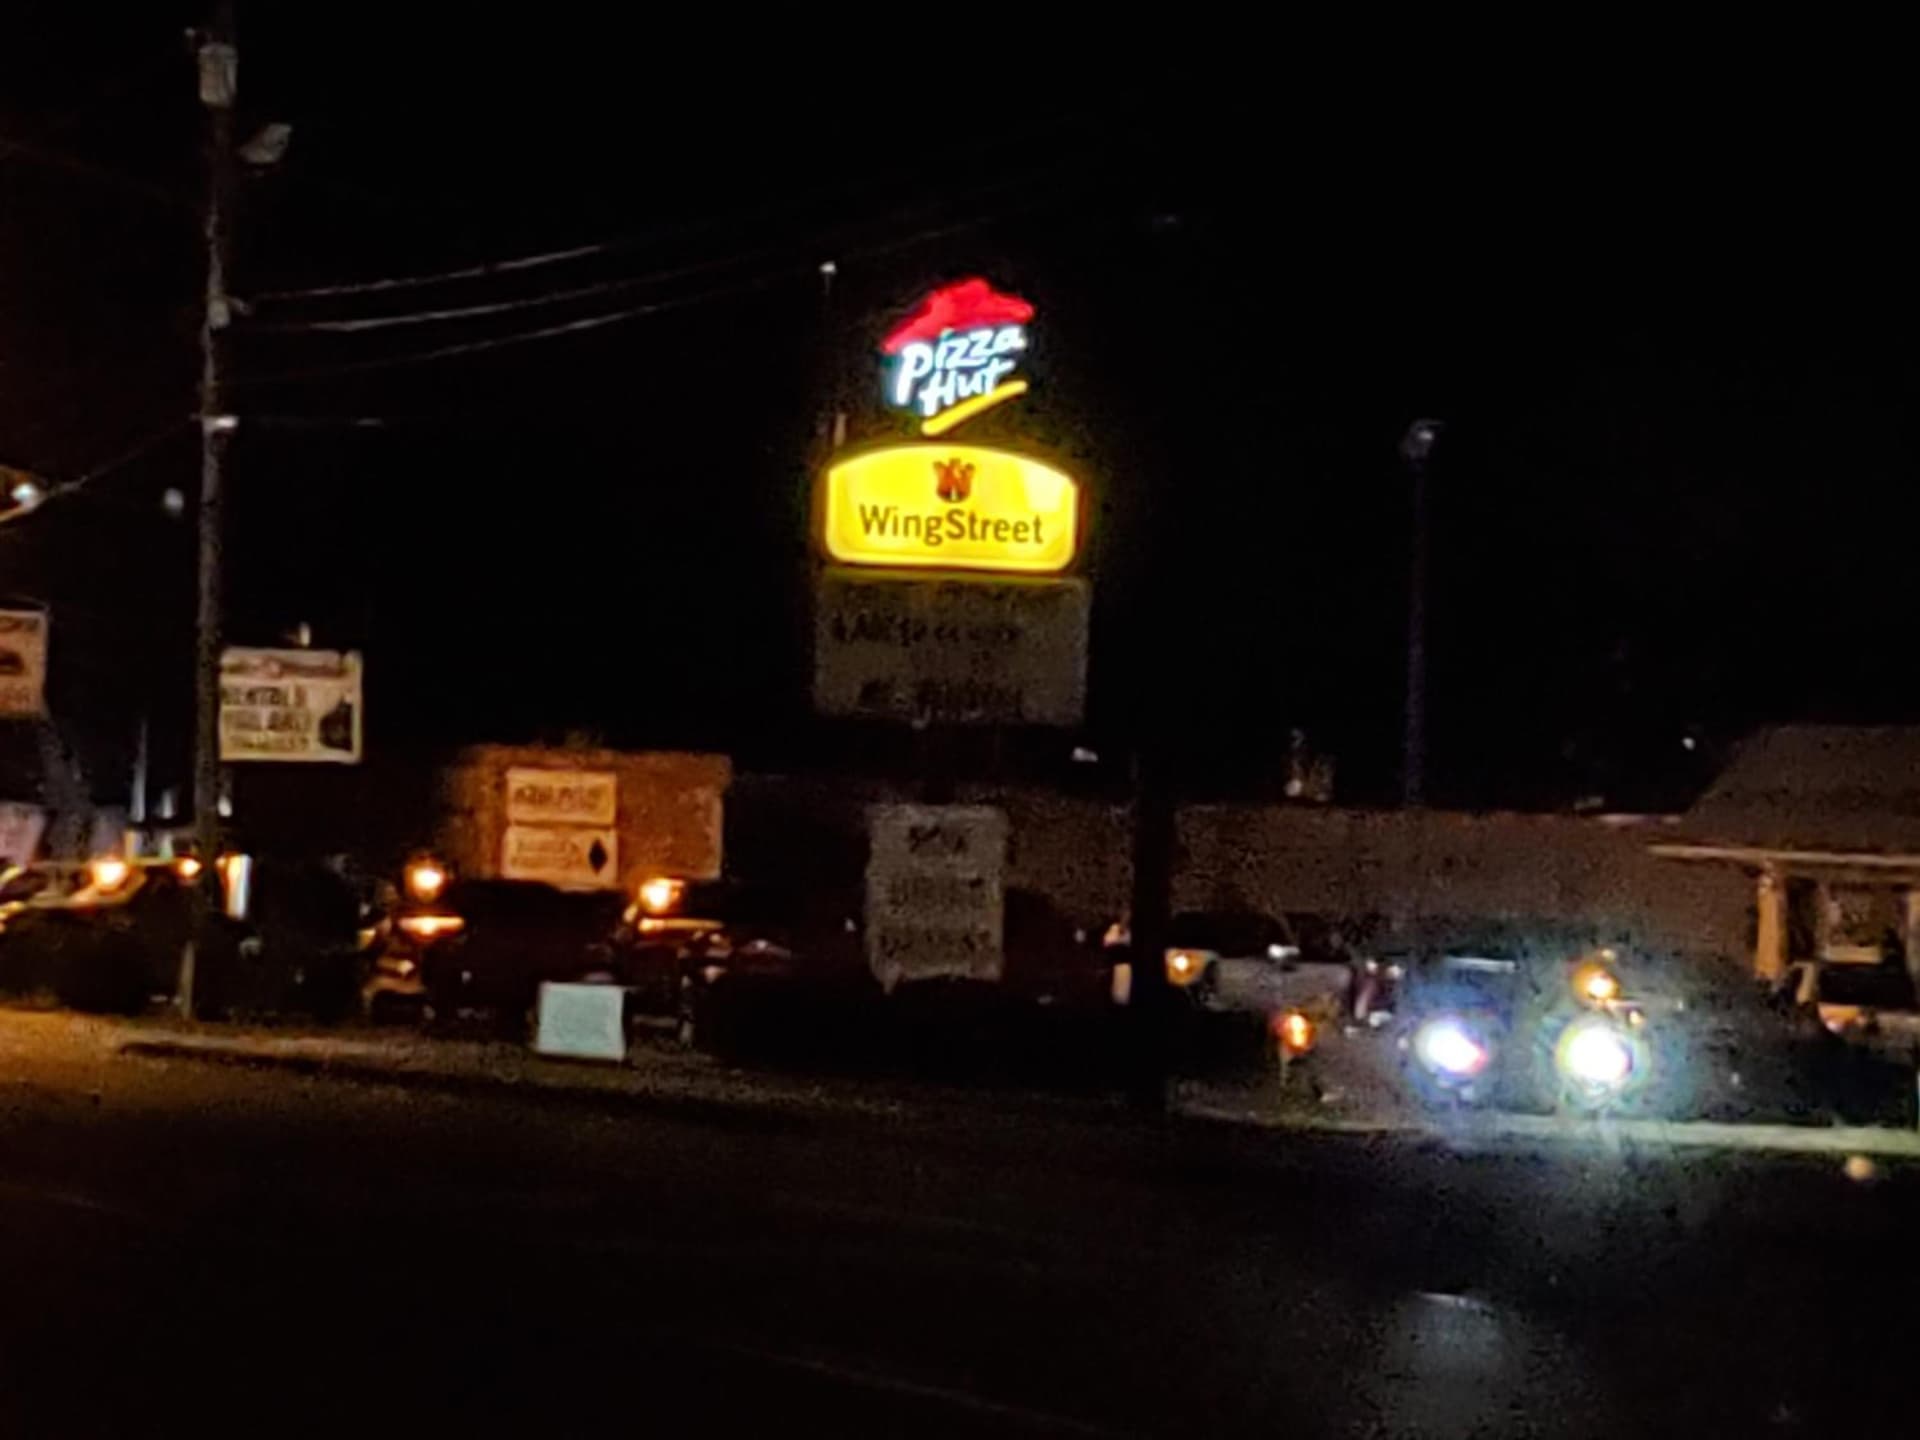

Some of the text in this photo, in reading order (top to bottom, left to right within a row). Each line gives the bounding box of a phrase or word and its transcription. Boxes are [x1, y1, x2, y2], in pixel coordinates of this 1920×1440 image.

[895, 325, 1027, 405] Pizza
[918, 360, 1016, 416] Hut
[859, 503, 1044, 547] WingStreet
